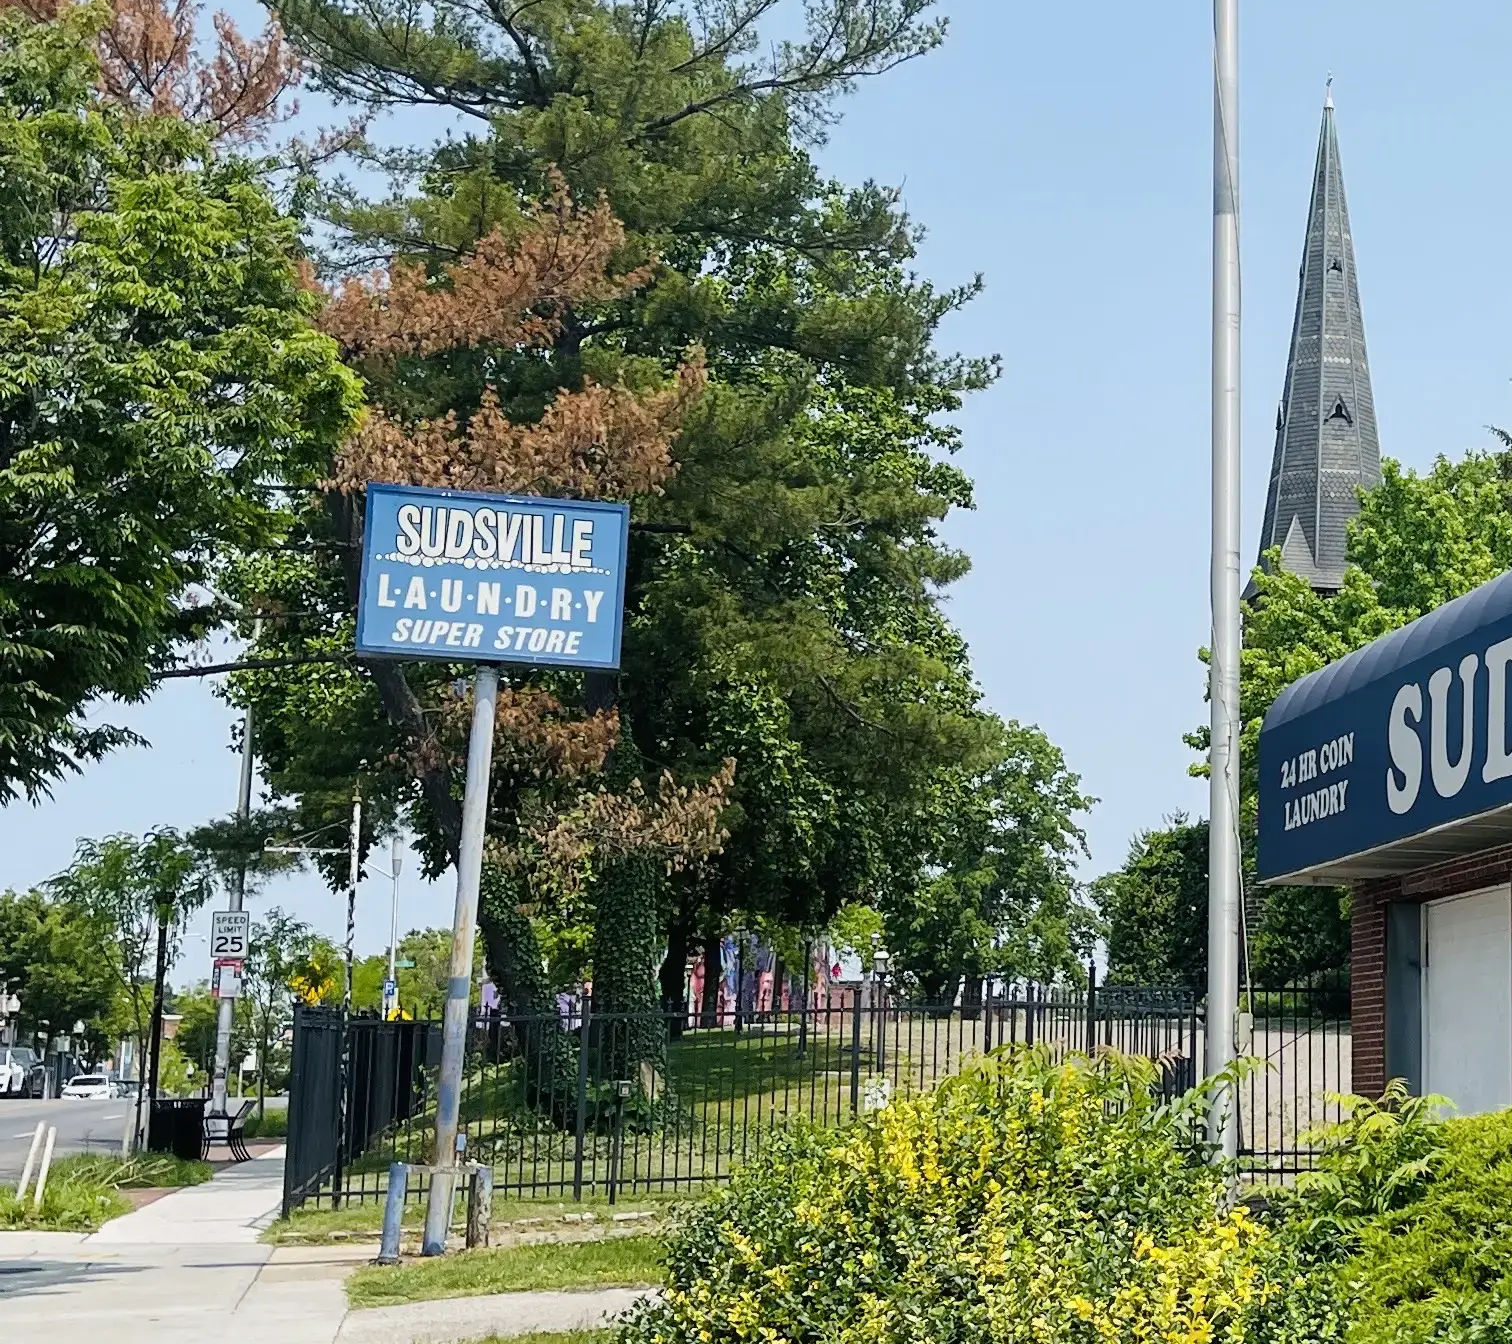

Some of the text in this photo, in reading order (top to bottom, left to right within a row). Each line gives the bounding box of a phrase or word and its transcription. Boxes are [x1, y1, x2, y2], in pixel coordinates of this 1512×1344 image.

[396, 504, 594, 567] SUDSVILLE
[392, 618, 583, 655] SUPER STORE
[1280, 731, 1355, 789] 24 HR COIN
[1284, 779, 1349, 831] LAUNDRY
[216, 916, 246, 925] SPEED
[218, 926, 242, 934] LIMIT
[215, 936, 243, 953] 25
